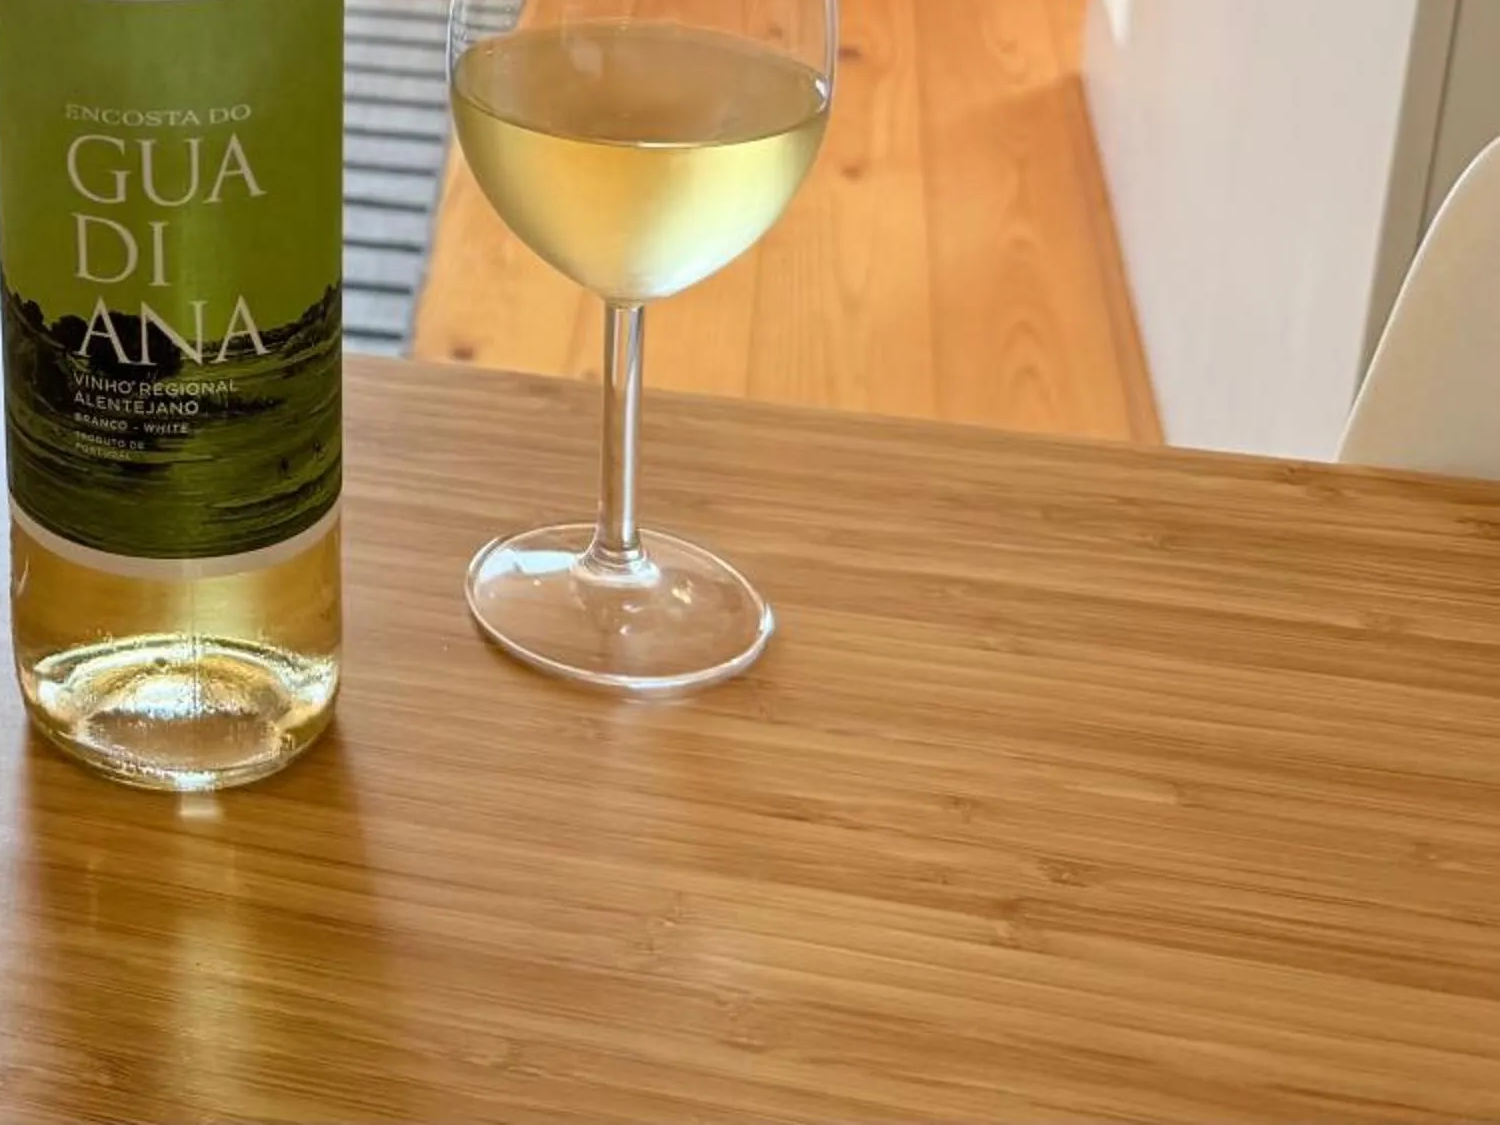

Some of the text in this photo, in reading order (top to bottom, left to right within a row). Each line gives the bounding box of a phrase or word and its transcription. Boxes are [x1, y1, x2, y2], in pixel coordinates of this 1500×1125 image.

[65, 103, 252, 126] ENCOSTA DO
[67, 132, 268, 207] GUA
[71, 212, 171, 287] DI
[73, 295, 272, 367] ANA
[74, 373, 239, 397] VINHO REGIONAL
[74, 390, 200, 416] ALENTEJANO
[73, 412, 128, 432] BRANCO
[143, 422, 190, 435] WHITE
